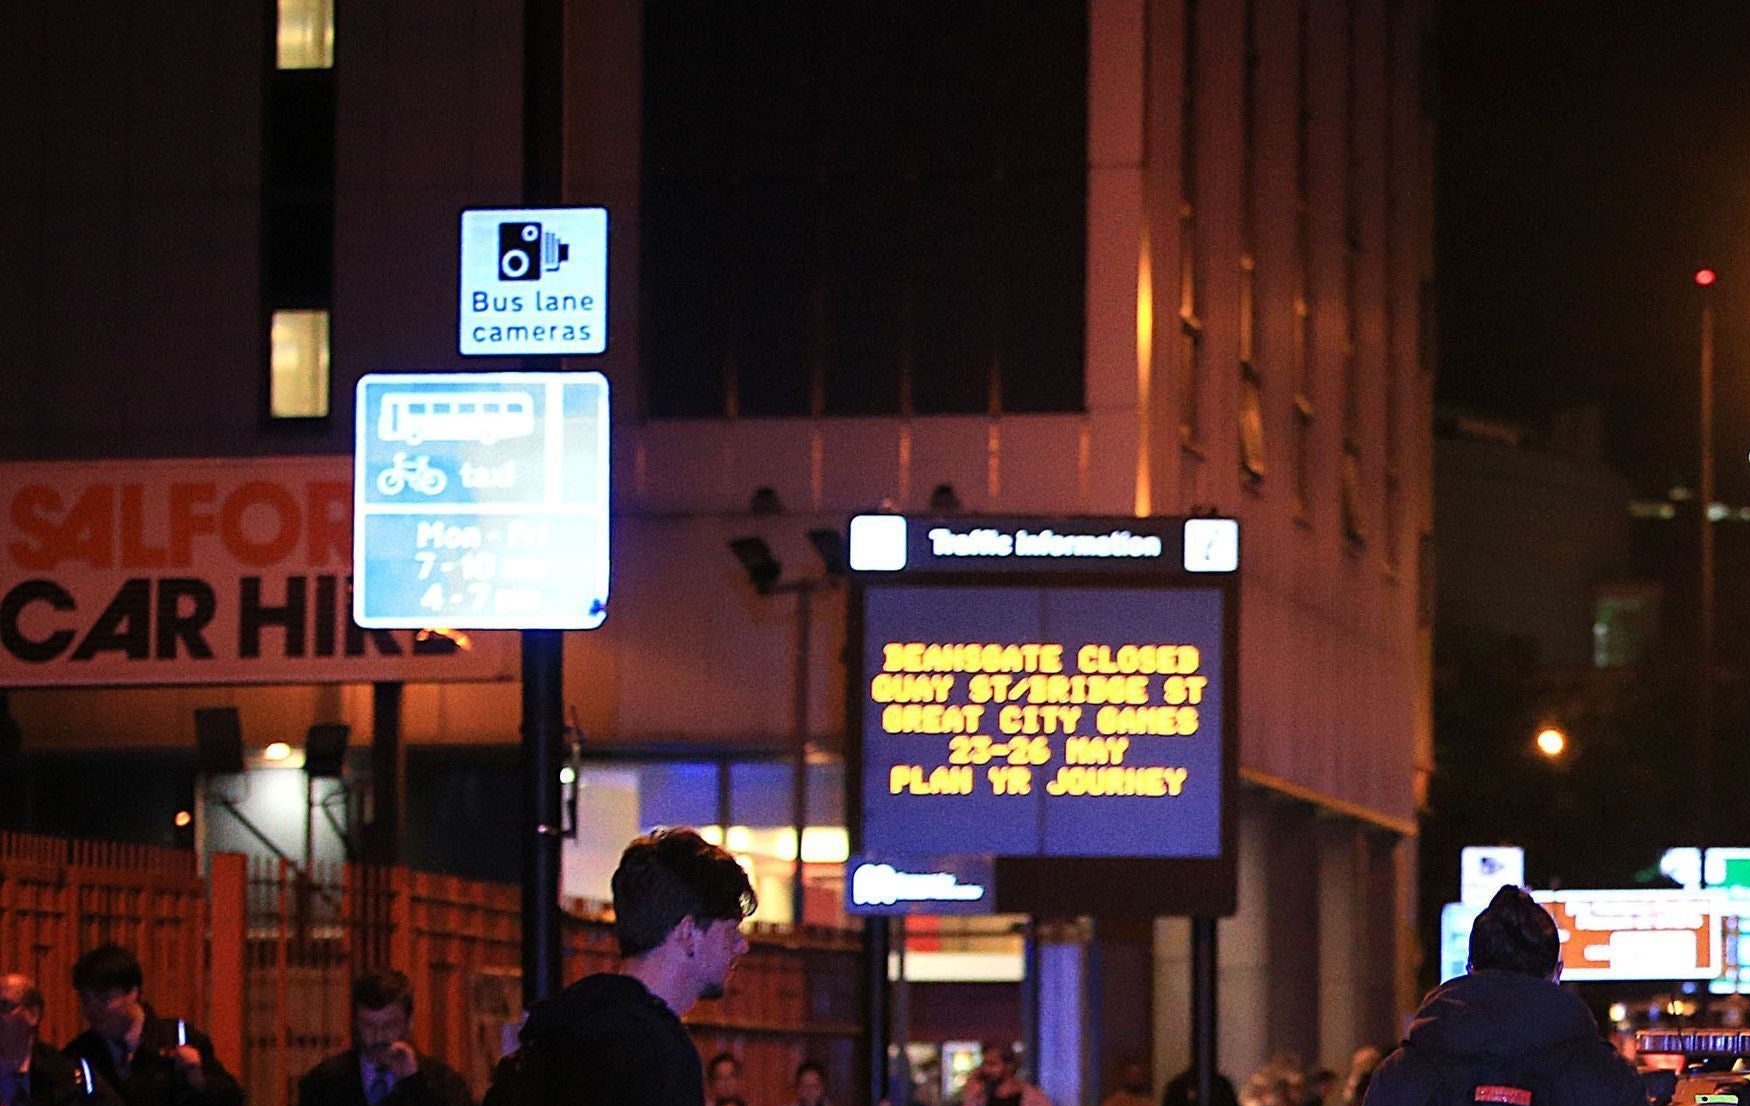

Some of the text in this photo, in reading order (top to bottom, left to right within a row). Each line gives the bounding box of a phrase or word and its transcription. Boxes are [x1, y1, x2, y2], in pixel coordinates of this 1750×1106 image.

[471, 290, 594, 313] Bus lane
[471, 321, 592, 341] cameras
[7, 481, 352, 571] SALFOR
[418, 523, 481, 548] Mon
[929, 528, 1162, 557] Traffic Information
[417, 553, 435, 579] 7
[421, 584, 443, 610] 4
[0, 578, 216, 663] CAR
[1077, 644, 1200, 674] CLOSED
[1163, 675, 1207, 705] ST
[882, 704, 1199, 735] GREAT CITY GAMES
[1065, 736, 1130, 765] MAY
[889, 765, 1187, 796] PLAN YR JOURNEY
